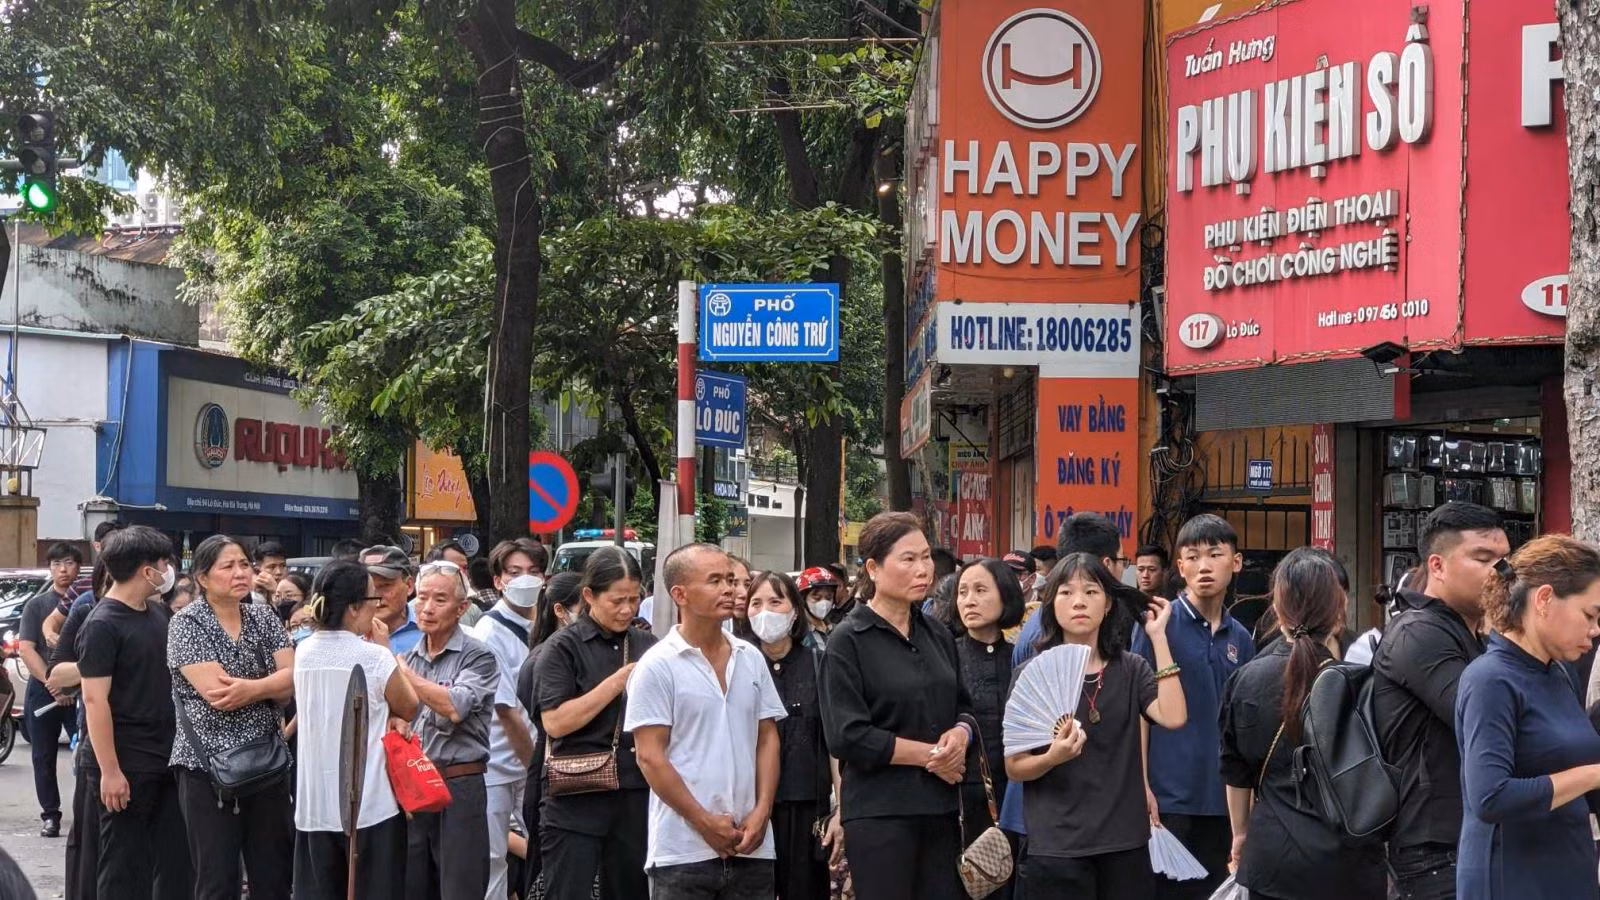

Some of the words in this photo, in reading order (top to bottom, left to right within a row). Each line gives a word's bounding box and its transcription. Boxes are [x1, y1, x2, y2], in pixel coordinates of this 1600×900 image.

[1185, 38, 1222, 77] Tuấn
[1229, 34, 1276, 65] Hưng
[1176, 89, 1258, 195] PHỤ
[1264, 56, 1361, 179] KIỆN
[1366, 6, 1434, 151] SỐ
[943, 139, 1137, 198] HAPPY
[940, 209, 1141, 267] MONEY
[1204, 220, 1241, 251] PHỤ
[1243, 206, 1285, 246] KIỆN
[1287, 197, 1333, 238] ĐIỆN
[1334, 190, 1398, 226] THOẠI
[1203, 255, 1231, 291] ĐỒ
[1232, 257, 1279, 288] CHƠI
[1280, 242, 1338, 278] CÔNG
[1340, 230, 1398, 271] NGHỆ
[754, 293, 796, 312] PHỐ
[713, 314, 761, 347] NGUYỄN
[766, 317, 799, 347] CÔNG
[804, 316, 829, 347] TRỨ
[1187, 320, 1210, 341] 117
[1226, 321, 1238, 338] Lò
[1240, 318, 1261, 338] Đúc
[713, 384, 731, 399] PHỐ
[696, 403, 712, 431] LÒ
[714, 405, 741, 435] ĐÚC
[1057, 404, 1082, 433] VAY
[1088, 394, 1126, 433] BẰNG
[1315, 425, 1329, 464] SỬA
[1057, 451, 1095, 485] ĐĂNG
[1101, 452, 1121, 487] KÝ
[1263, 466, 1272, 479] 117
[1044, 503, 1054, 539] Ô
[1315, 509, 1332, 539] THAY
